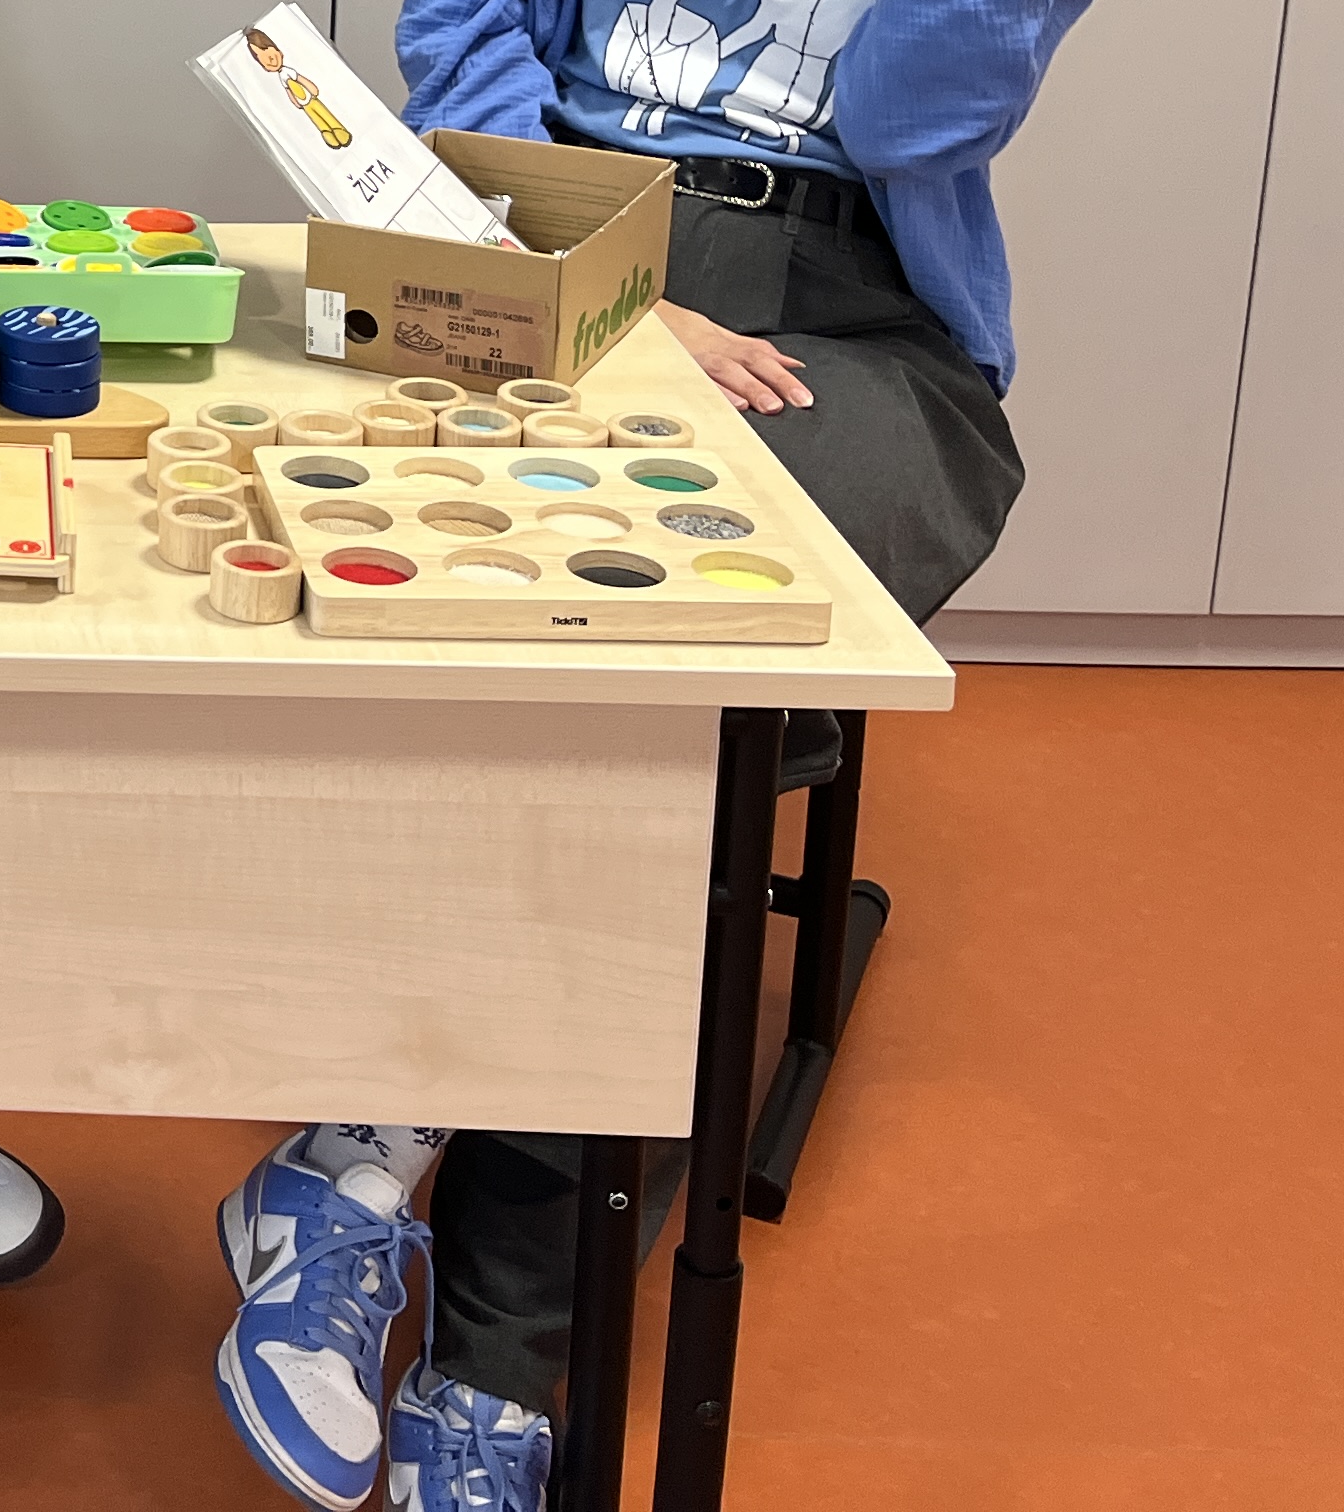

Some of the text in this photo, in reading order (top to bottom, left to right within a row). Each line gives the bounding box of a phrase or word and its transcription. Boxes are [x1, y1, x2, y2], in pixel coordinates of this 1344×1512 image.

[346, 158, 396, 203] ŽUTA
[447, 321, 500, 338] G2150129-1
[572, 263, 652, 372] froddo
[489, 347, 502, 358] 22
